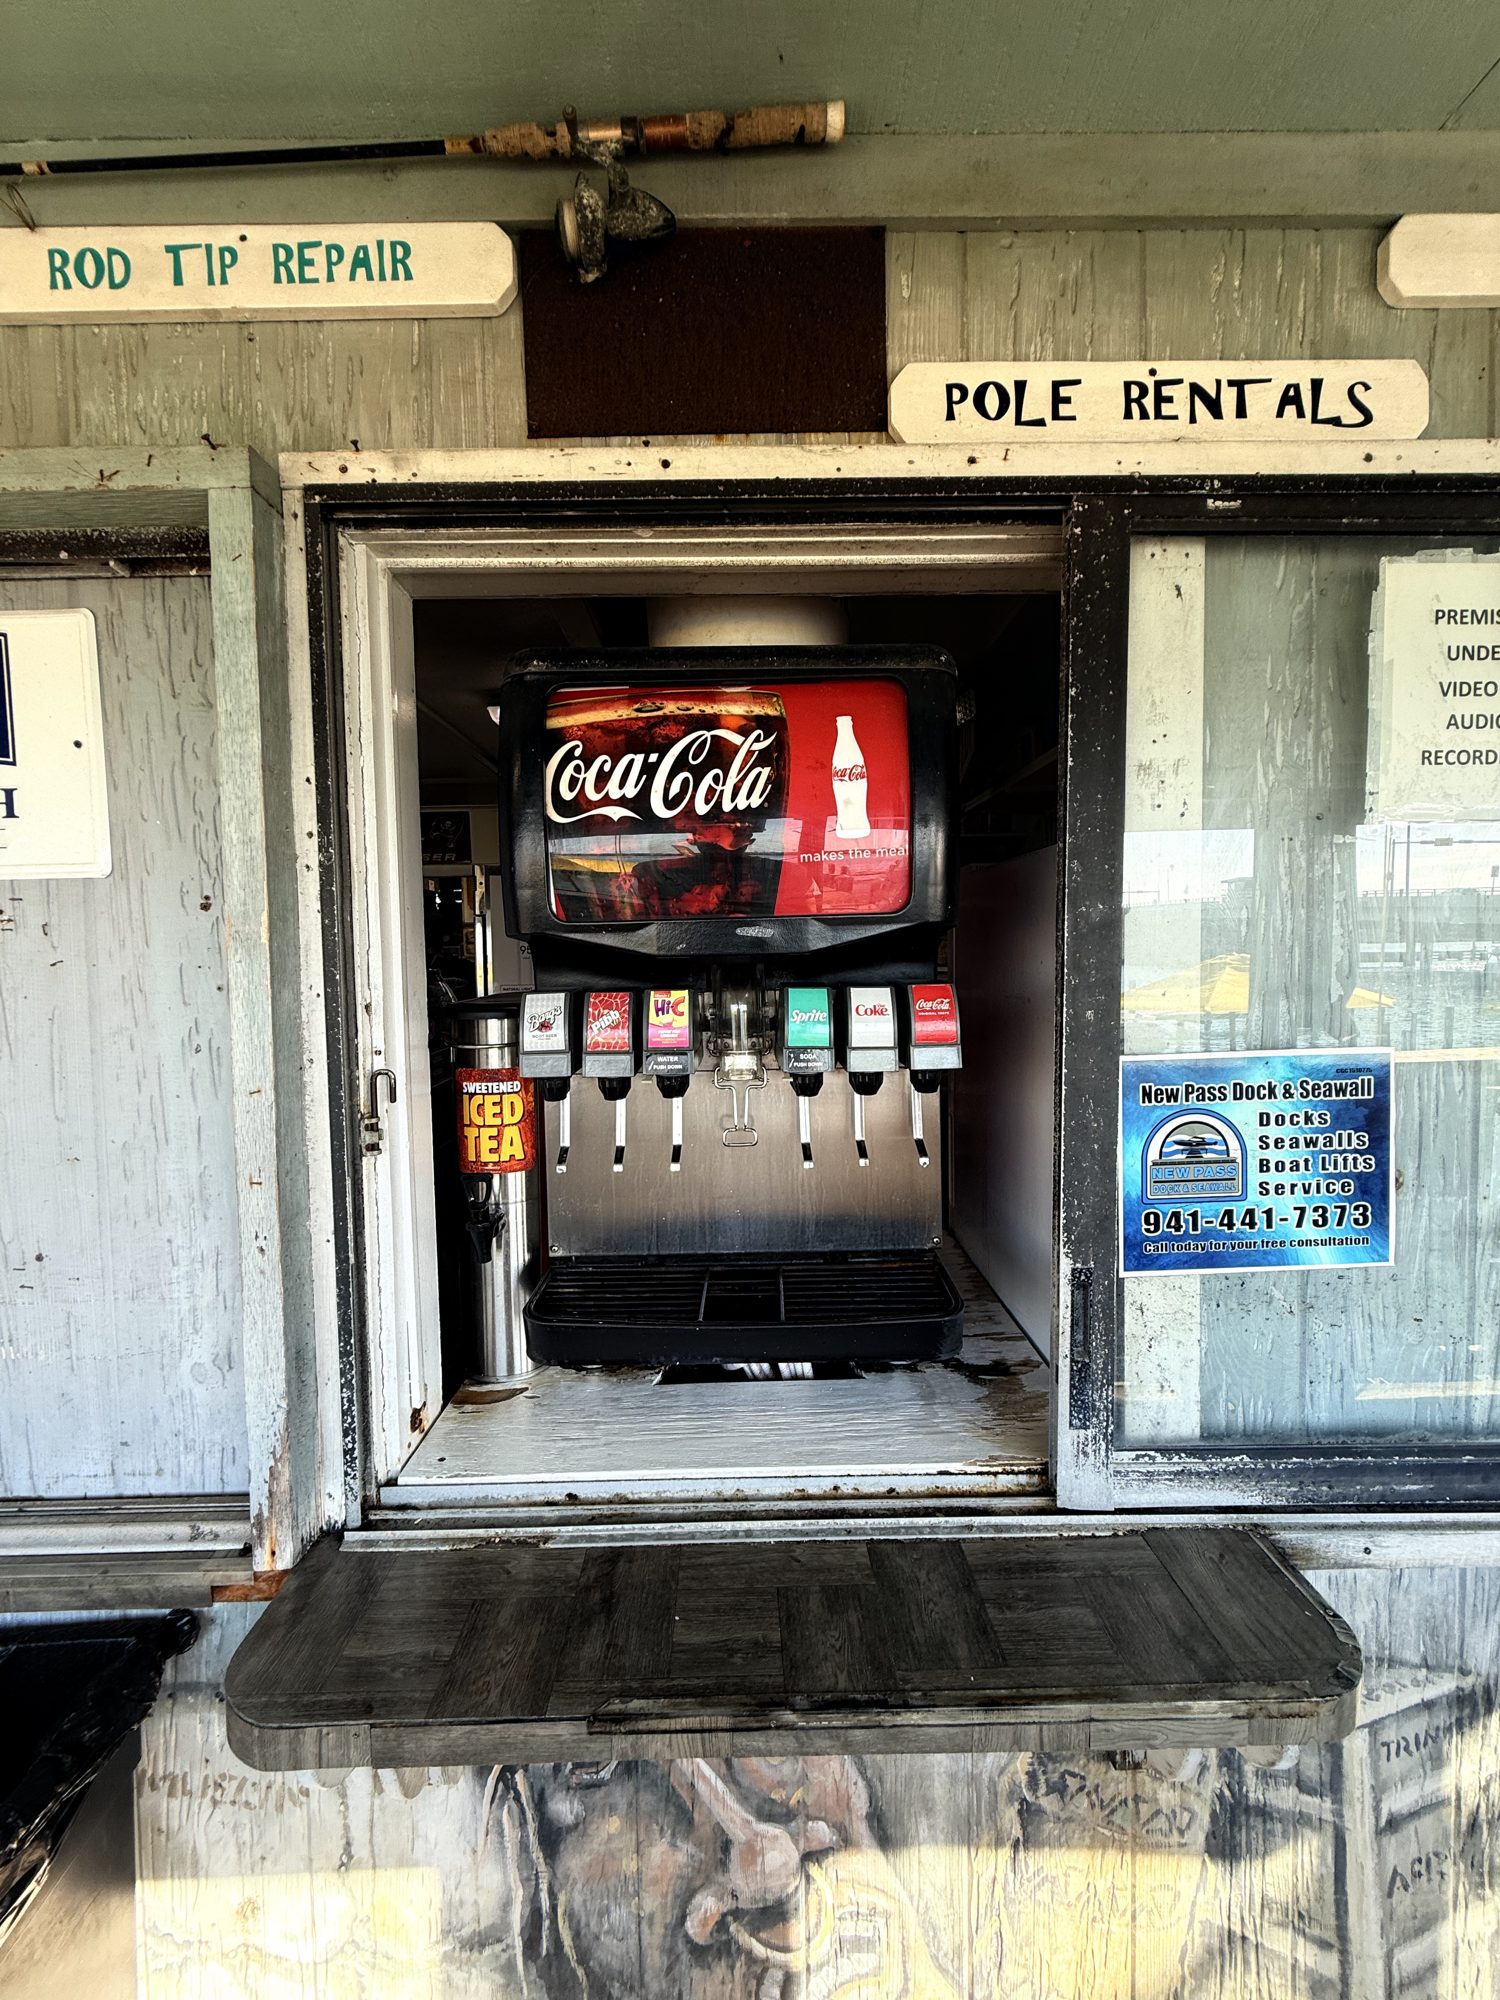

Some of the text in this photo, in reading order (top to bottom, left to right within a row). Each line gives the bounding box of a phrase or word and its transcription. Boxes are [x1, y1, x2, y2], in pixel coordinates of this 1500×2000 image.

[48, 238, 414, 290] ROD TIP REPAIR
[944, 376, 1374, 429] POLE RENTALS
[1439, 681, 1499, 697] VIDEO
[1446, 713, 1500, 730] AUDI
[1421, 749, 1500, 766] RECORD
[545, 728, 778, 825] Coca-Cola
[800, 844, 909, 863] makes the meal
[855, 1003, 889, 1017] Coke
[916, 998, 951, 1011] Coca-Cola
[591, 1010, 620, 1035] Pibb
[791, 1009, 827, 1025] Sprite
[463, 1081, 521, 1094] SWEETENED
[1141, 1077, 1373, 1104] New Pass Dock & Seawall
[463, 1094, 524, 1126] ICED
[1259, 1111, 1330, 1127] Docks
[464, 1125, 525, 1162] TEA
[1259, 1131, 1369, 1150] Seawalls
[1152, 1165, 1237, 1179] NEW PASS
[1259, 1154, 1374, 1174] Boat Lifts
[1153, 1182, 1236, 1193] DOCK & SEAWALL
[1259, 1179, 1354, 1196] Service
[1143, 1204, 1371, 1234] 941-441-7373
[1144, 1235, 1370, 1253] Call today for your free consultation
